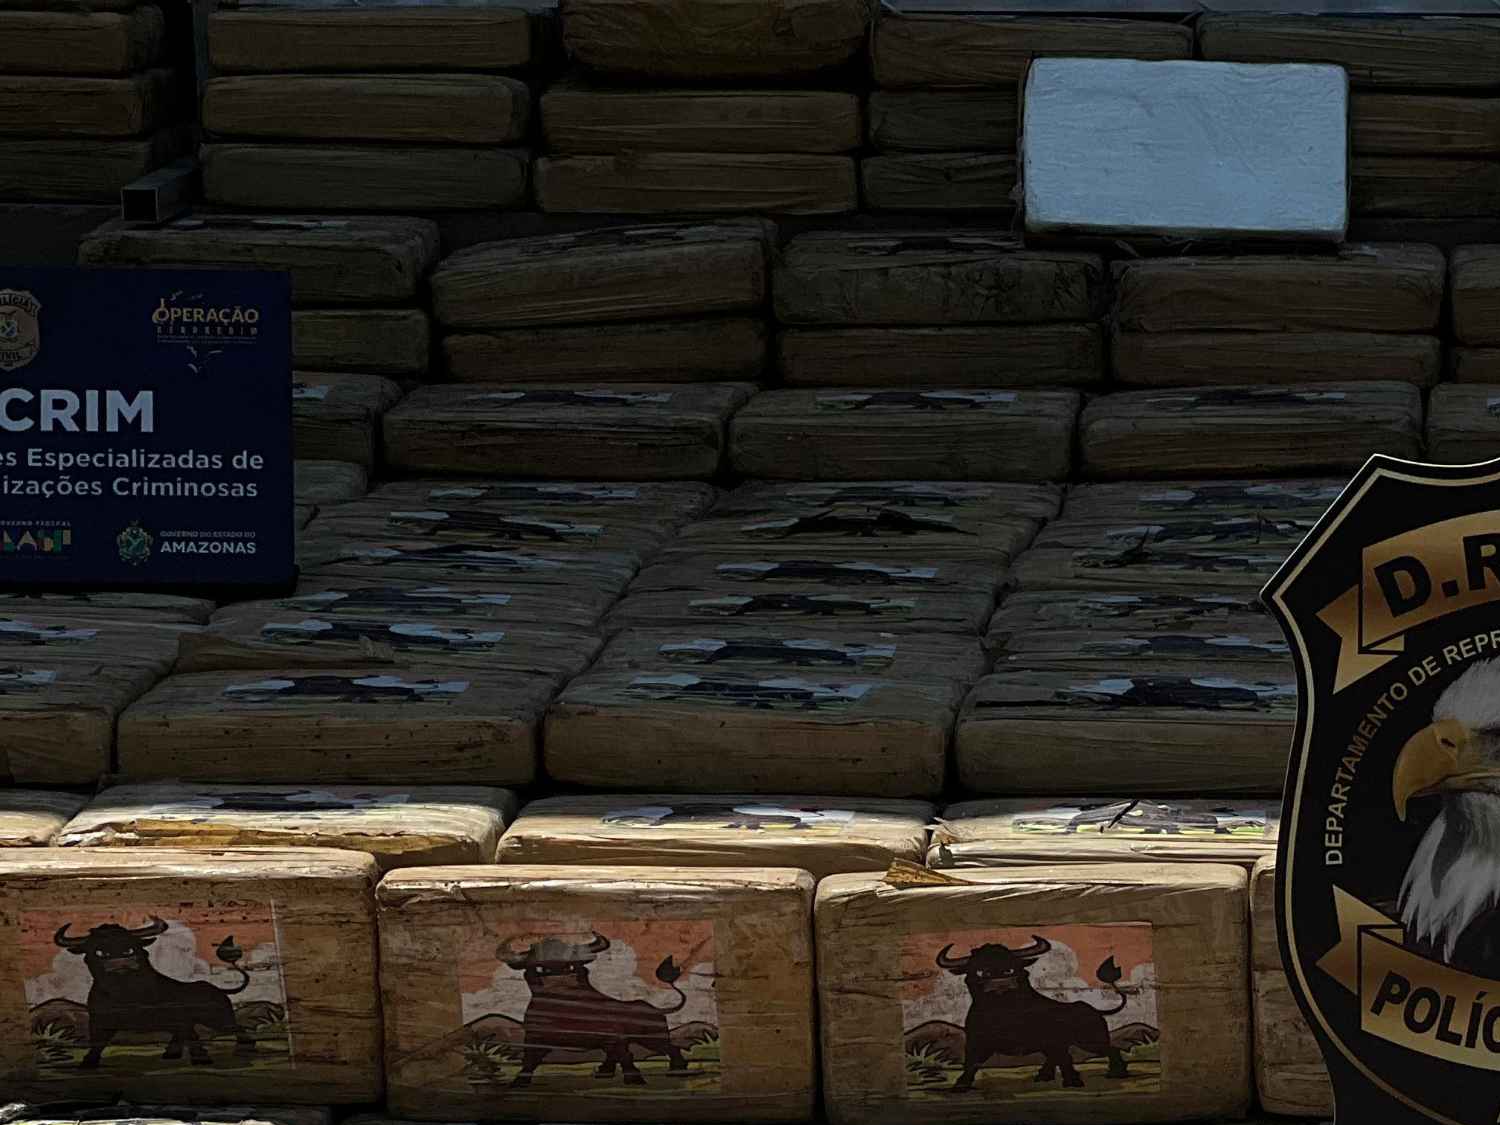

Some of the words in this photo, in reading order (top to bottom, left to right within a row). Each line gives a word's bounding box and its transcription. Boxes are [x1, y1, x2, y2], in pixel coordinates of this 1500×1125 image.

[152, 301, 259, 326] OPERAÇÃO
[0, 388, 154, 433] CRIM
[27, 448, 223, 470] Especializadas
[232, 450, 265, 469] de
[113, 476, 258, 497] Criminosas
[160, 541, 257, 554] AMAZONAS
[1325, 681, 1408, 866] DEPARTAMENTO
[1408, 655, 1441, 687] DE
